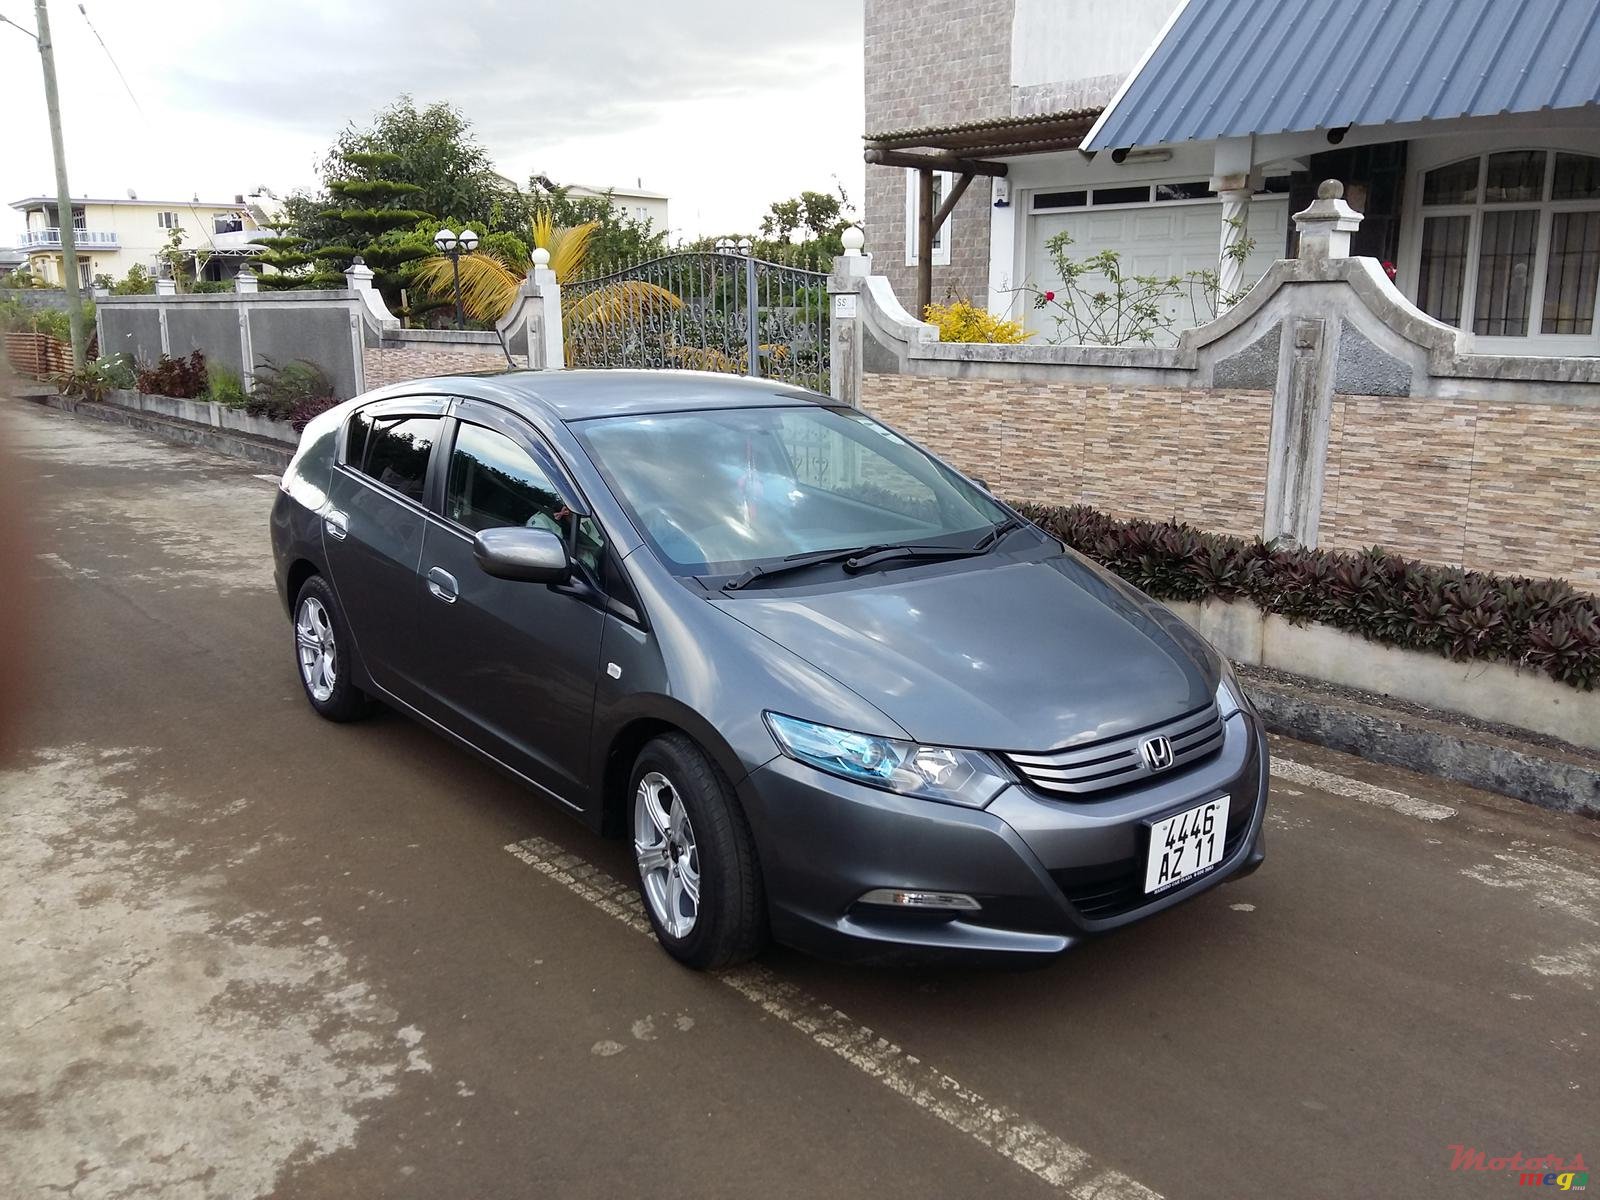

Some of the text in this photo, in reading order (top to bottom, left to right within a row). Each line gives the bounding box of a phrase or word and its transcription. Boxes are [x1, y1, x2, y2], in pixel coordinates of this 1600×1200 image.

[1165, 804, 1215, 850] 4446
[1158, 846, 1184, 885] AZ
[1195, 833, 1215, 868] 11
